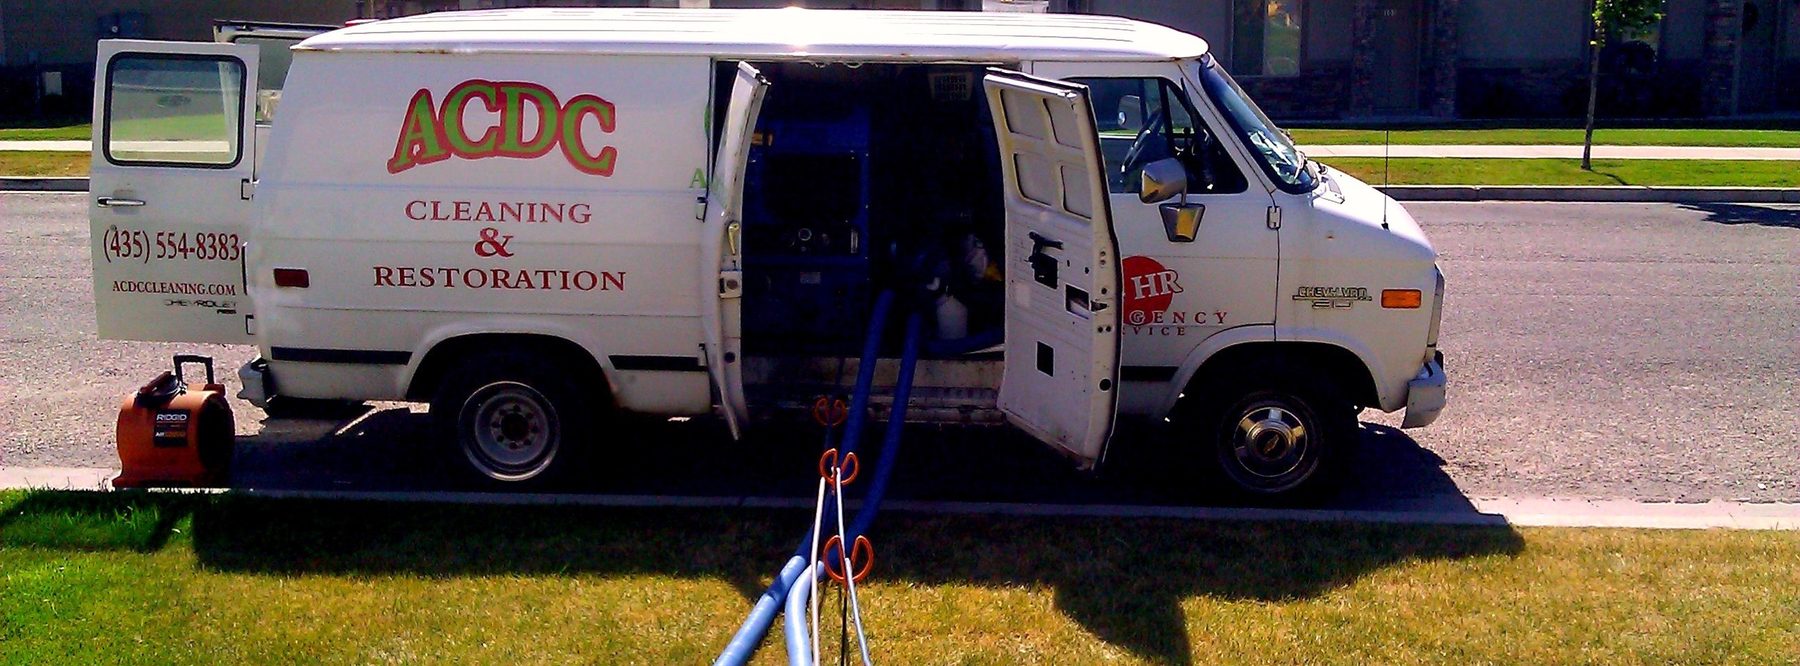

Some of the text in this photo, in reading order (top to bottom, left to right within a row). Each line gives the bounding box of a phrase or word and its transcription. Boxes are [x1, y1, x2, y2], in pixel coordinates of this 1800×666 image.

[387, 79, 617, 177] ACDC
[404, 200, 592, 224] CLEANING
[103, 229, 240, 264] (435) 554-8383
[474, 227, 515, 258] &
[112, 280, 236, 296] ACDCCLEANING.COM
[373, 266, 626, 291] RESTORATION
[1131, 269, 1184, 300] HR
